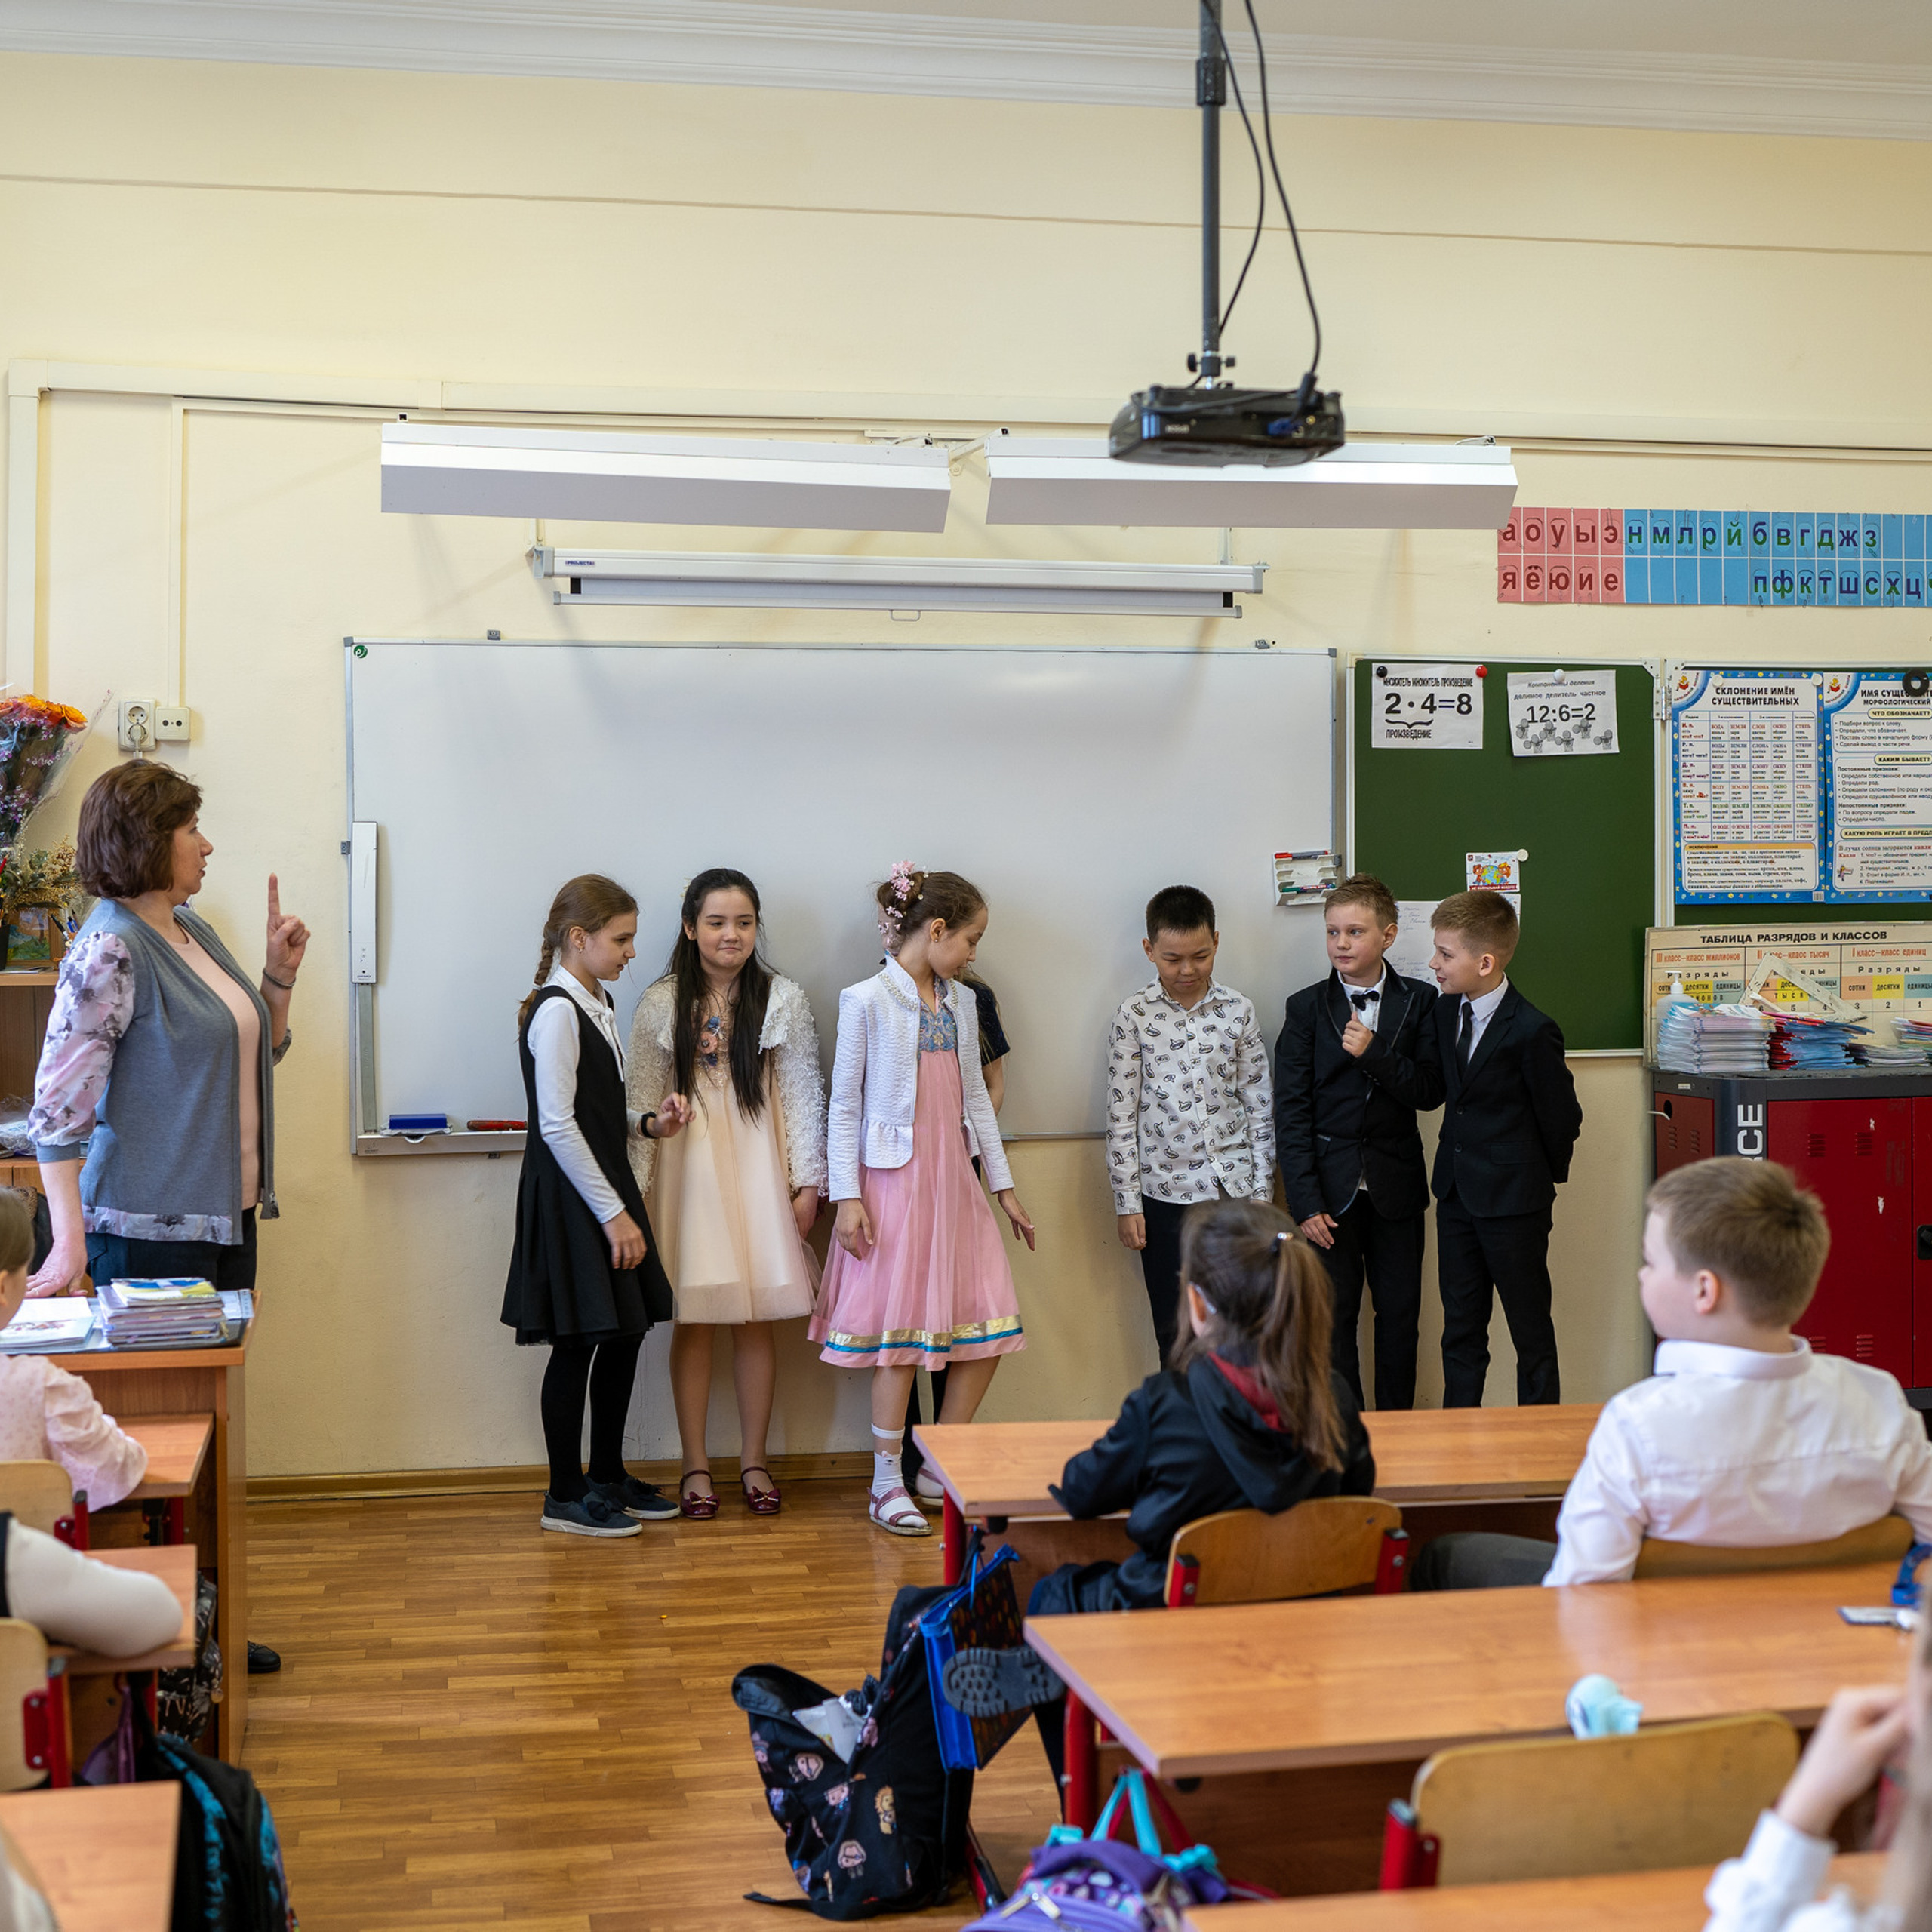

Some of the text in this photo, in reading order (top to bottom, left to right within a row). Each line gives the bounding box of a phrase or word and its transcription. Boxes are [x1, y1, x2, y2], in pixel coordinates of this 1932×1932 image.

[1412, 678, 1440, 687] МНОЖИТЕЛЬ
[1441, 678, 1473, 688] ПРОИЗВЕДЕНИЕ
[1715, 685, 1795, 695] СКЛОНЕНИЕ ИМЁН
[1861, 689, 1879, 697] ИМЯ
[1712, 697, 1799, 706] СУЩЕСТВИТЕЛЬНЫХ
[1527, 703, 1596, 724] 12:6=2
[1386, 729, 1432, 740] ПРОИЗВЕДЕНИЕ
[1700, 934, 1752, 944] ТАБЛИЦА
[1757, 933, 1816, 943] РАЗРЯДОВ
[1832, 931, 1887, 940] КЛАССОВ
[1706, 953, 1741, 961] миллионов
[1903, 948, 1927, 957] единиц
[1858, 966, 1921, 974] Разряды
[1737, 1104, 1763, 1161] CE
